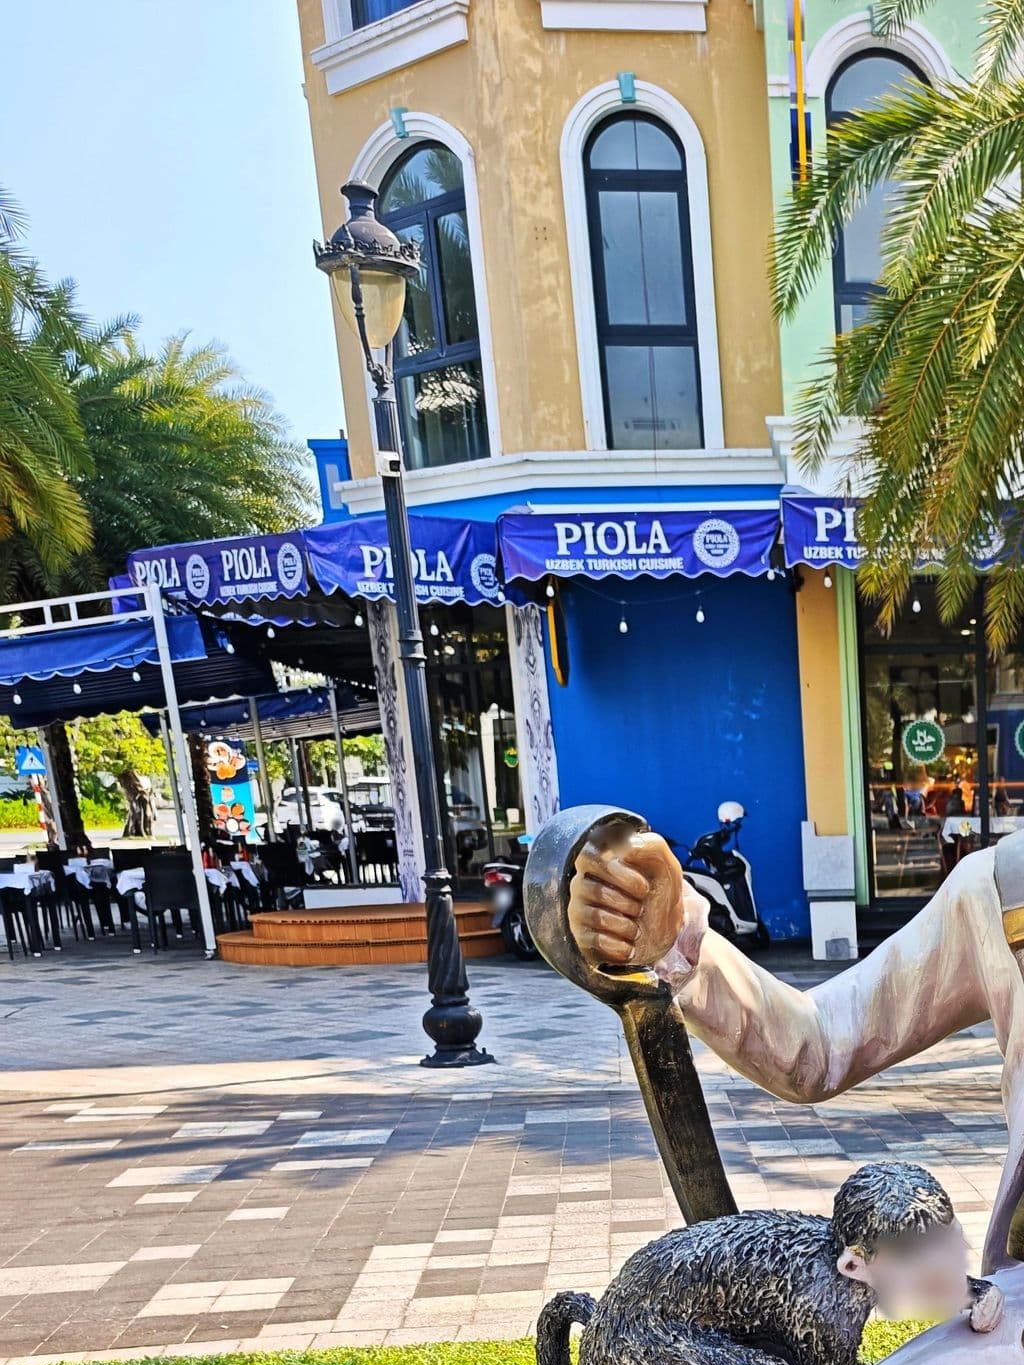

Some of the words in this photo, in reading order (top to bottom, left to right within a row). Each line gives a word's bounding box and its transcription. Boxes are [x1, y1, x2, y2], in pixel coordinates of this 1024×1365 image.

[554, 520, 672, 556] PIOLA
[221, 545, 272, 581] PIOLA
[545, 558, 585, 571] UZBEK
[586, 558, 637, 571] TURKISH
[638, 557, 684, 570] CUISINE
[804, 546, 845, 560] UZBEK
[133, 557, 181, 588] PIOLA
[430, 585, 465, 598] CUISINE
